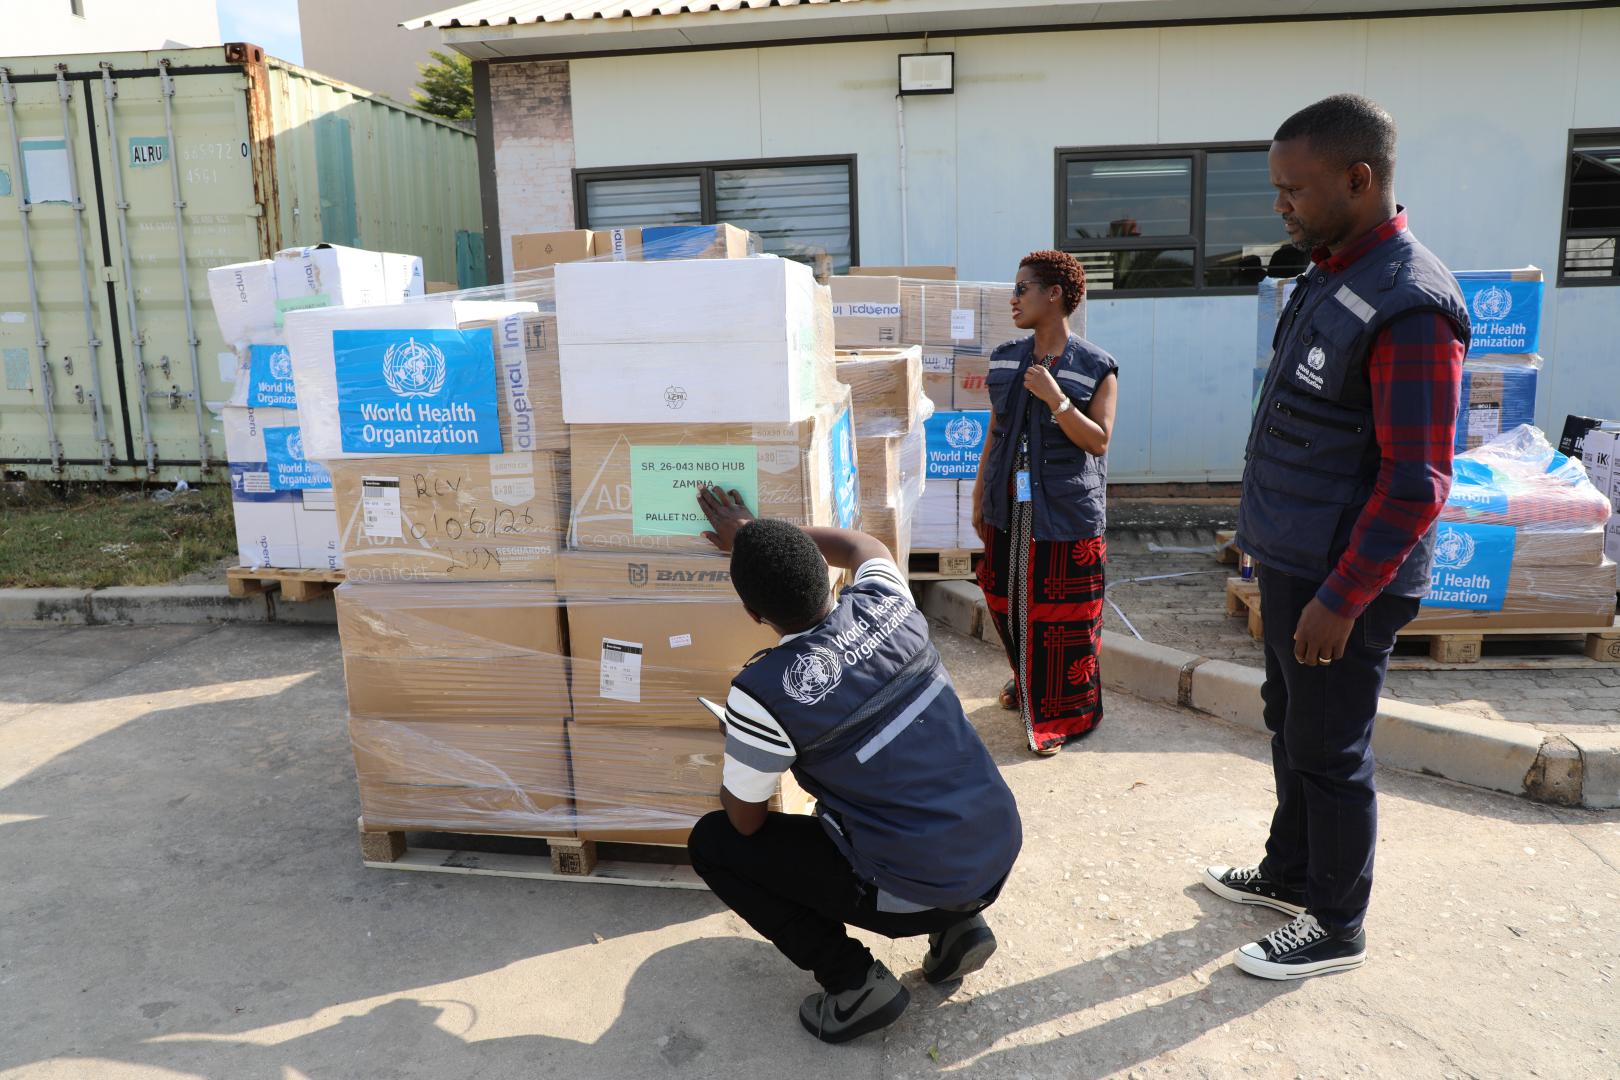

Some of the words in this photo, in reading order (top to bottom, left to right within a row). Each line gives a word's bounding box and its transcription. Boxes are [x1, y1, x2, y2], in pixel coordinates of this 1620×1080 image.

[134, 146, 162, 162] ALRU
[1490, 323, 1527, 335] Health
[1295, 369, 1322, 390] Organization
[1298, 363, 1310, 376] World
[1308, 371, 1324, 385] Health
[258, 382, 282, 392] World
[360, 402, 412, 421] World
[418, 402, 476, 422] Health
[362, 424, 479, 448] Organization
[930, 451, 961, 461] World
[278, 463, 302, 473] World
[660, 462, 694, 471] 26-043
[696, 462, 720, 471] NBO
[722, 462, 745, 471] HUB
[645, 513, 679, 521] PALLET
[1444, 572, 1491, 589] Health
[831, 616, 871, 651] World
[844, 600, 913, 666] Organization
